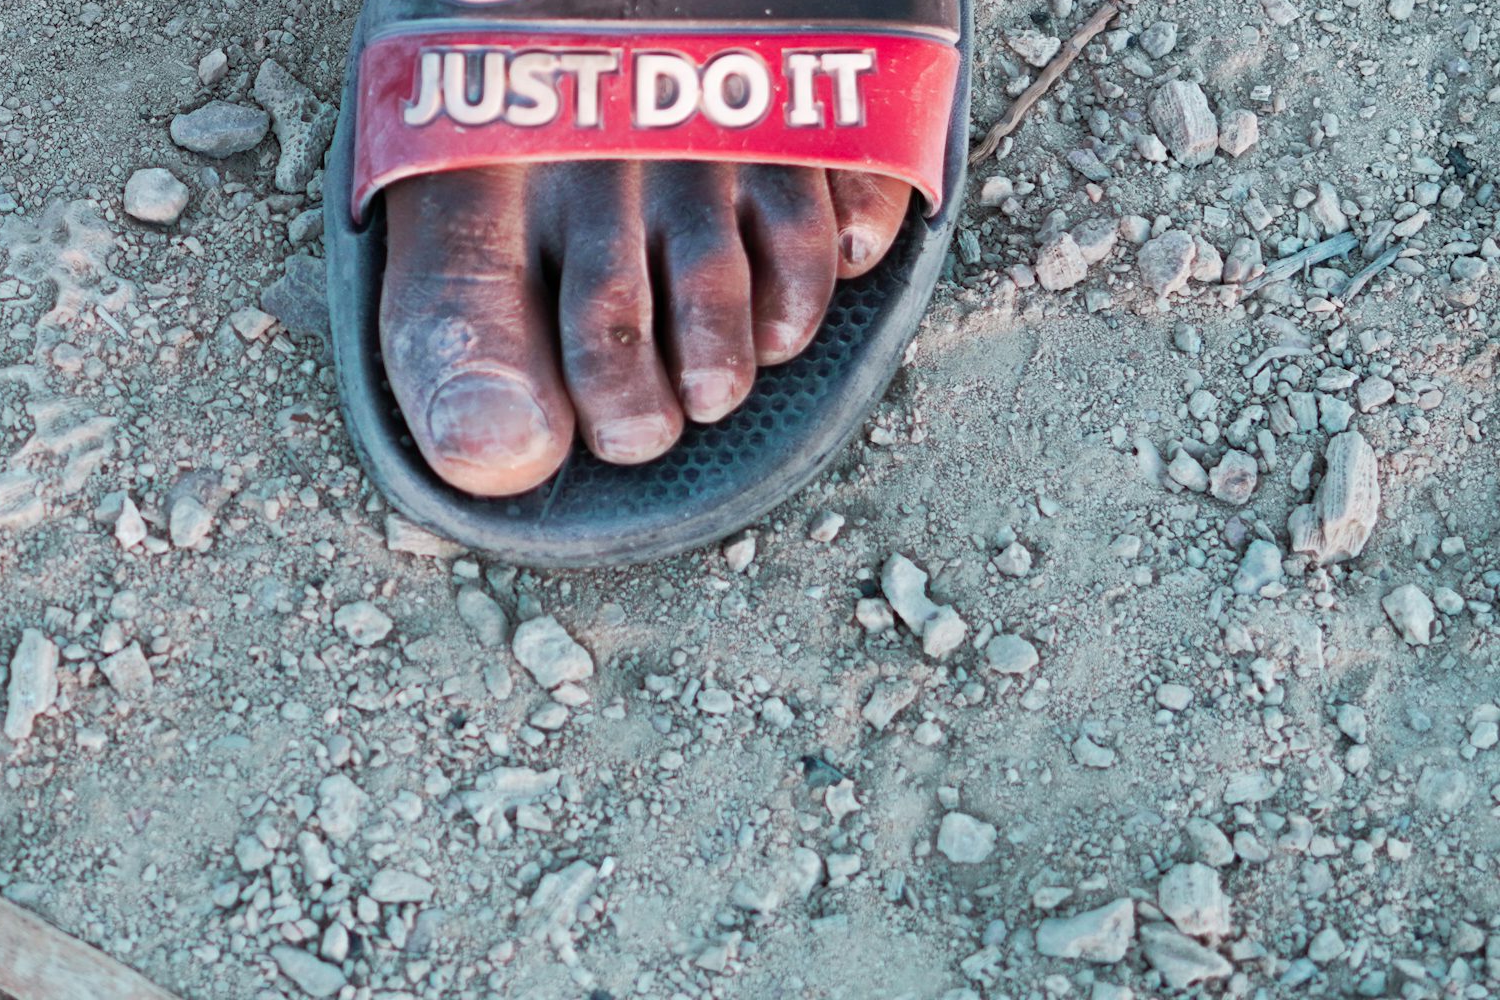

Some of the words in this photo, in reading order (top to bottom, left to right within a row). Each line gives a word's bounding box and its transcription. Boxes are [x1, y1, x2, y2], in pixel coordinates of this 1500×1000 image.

[403, 51, 619, 127] JUST
[636, 52, 770, 128] DO
[788, 51, 873, 126] IT
